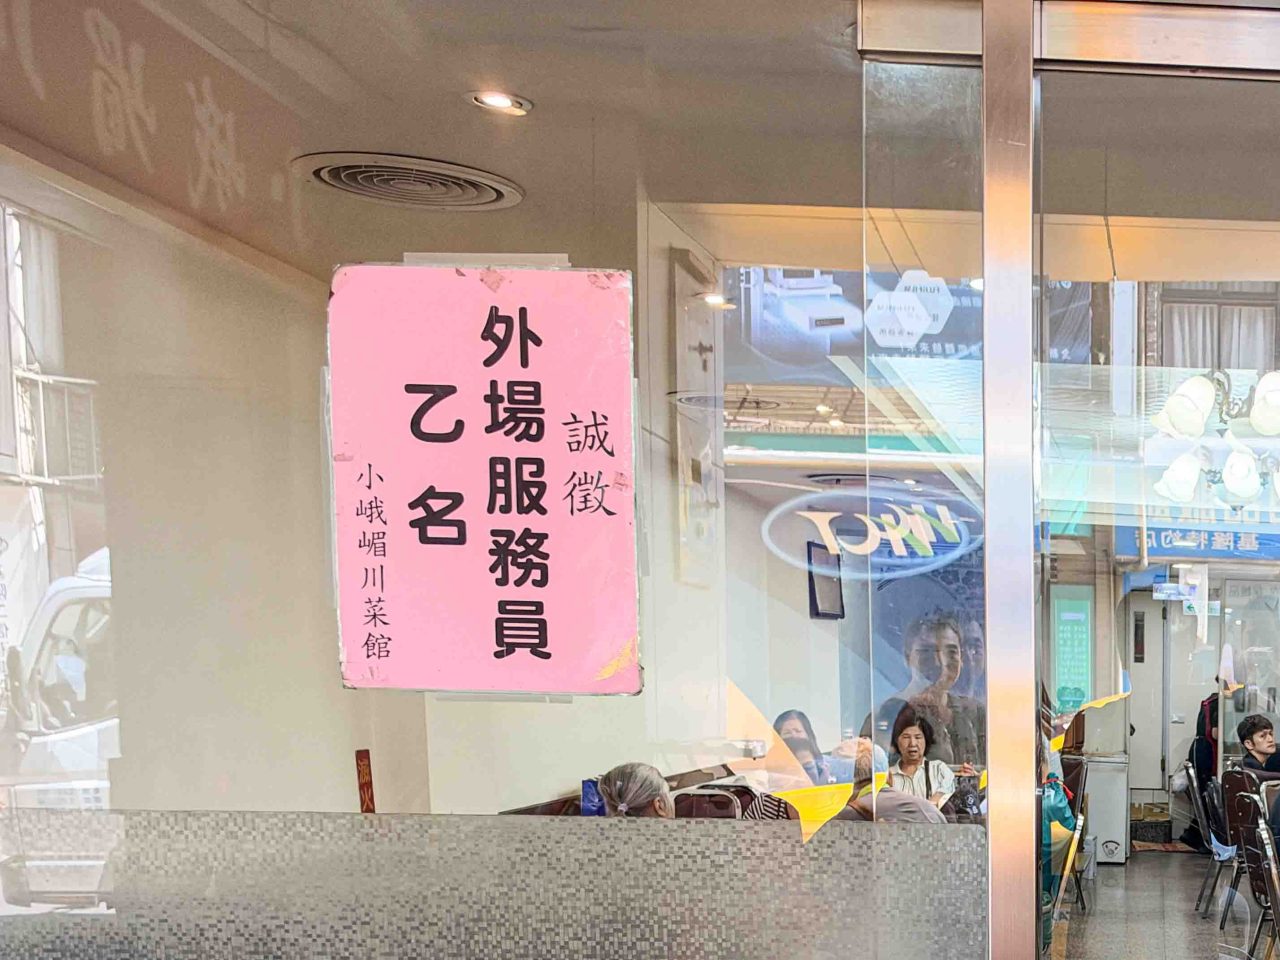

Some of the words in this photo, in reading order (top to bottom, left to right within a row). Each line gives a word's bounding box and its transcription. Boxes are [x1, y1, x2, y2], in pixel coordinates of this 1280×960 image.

[404, 383, 467, 546] 乙名
[481, 305, 552, 661] 外場服務員
[561, 410, 617, 517] 誠徵
[356, 463, 392, 660] 小峨嵋川菜館
